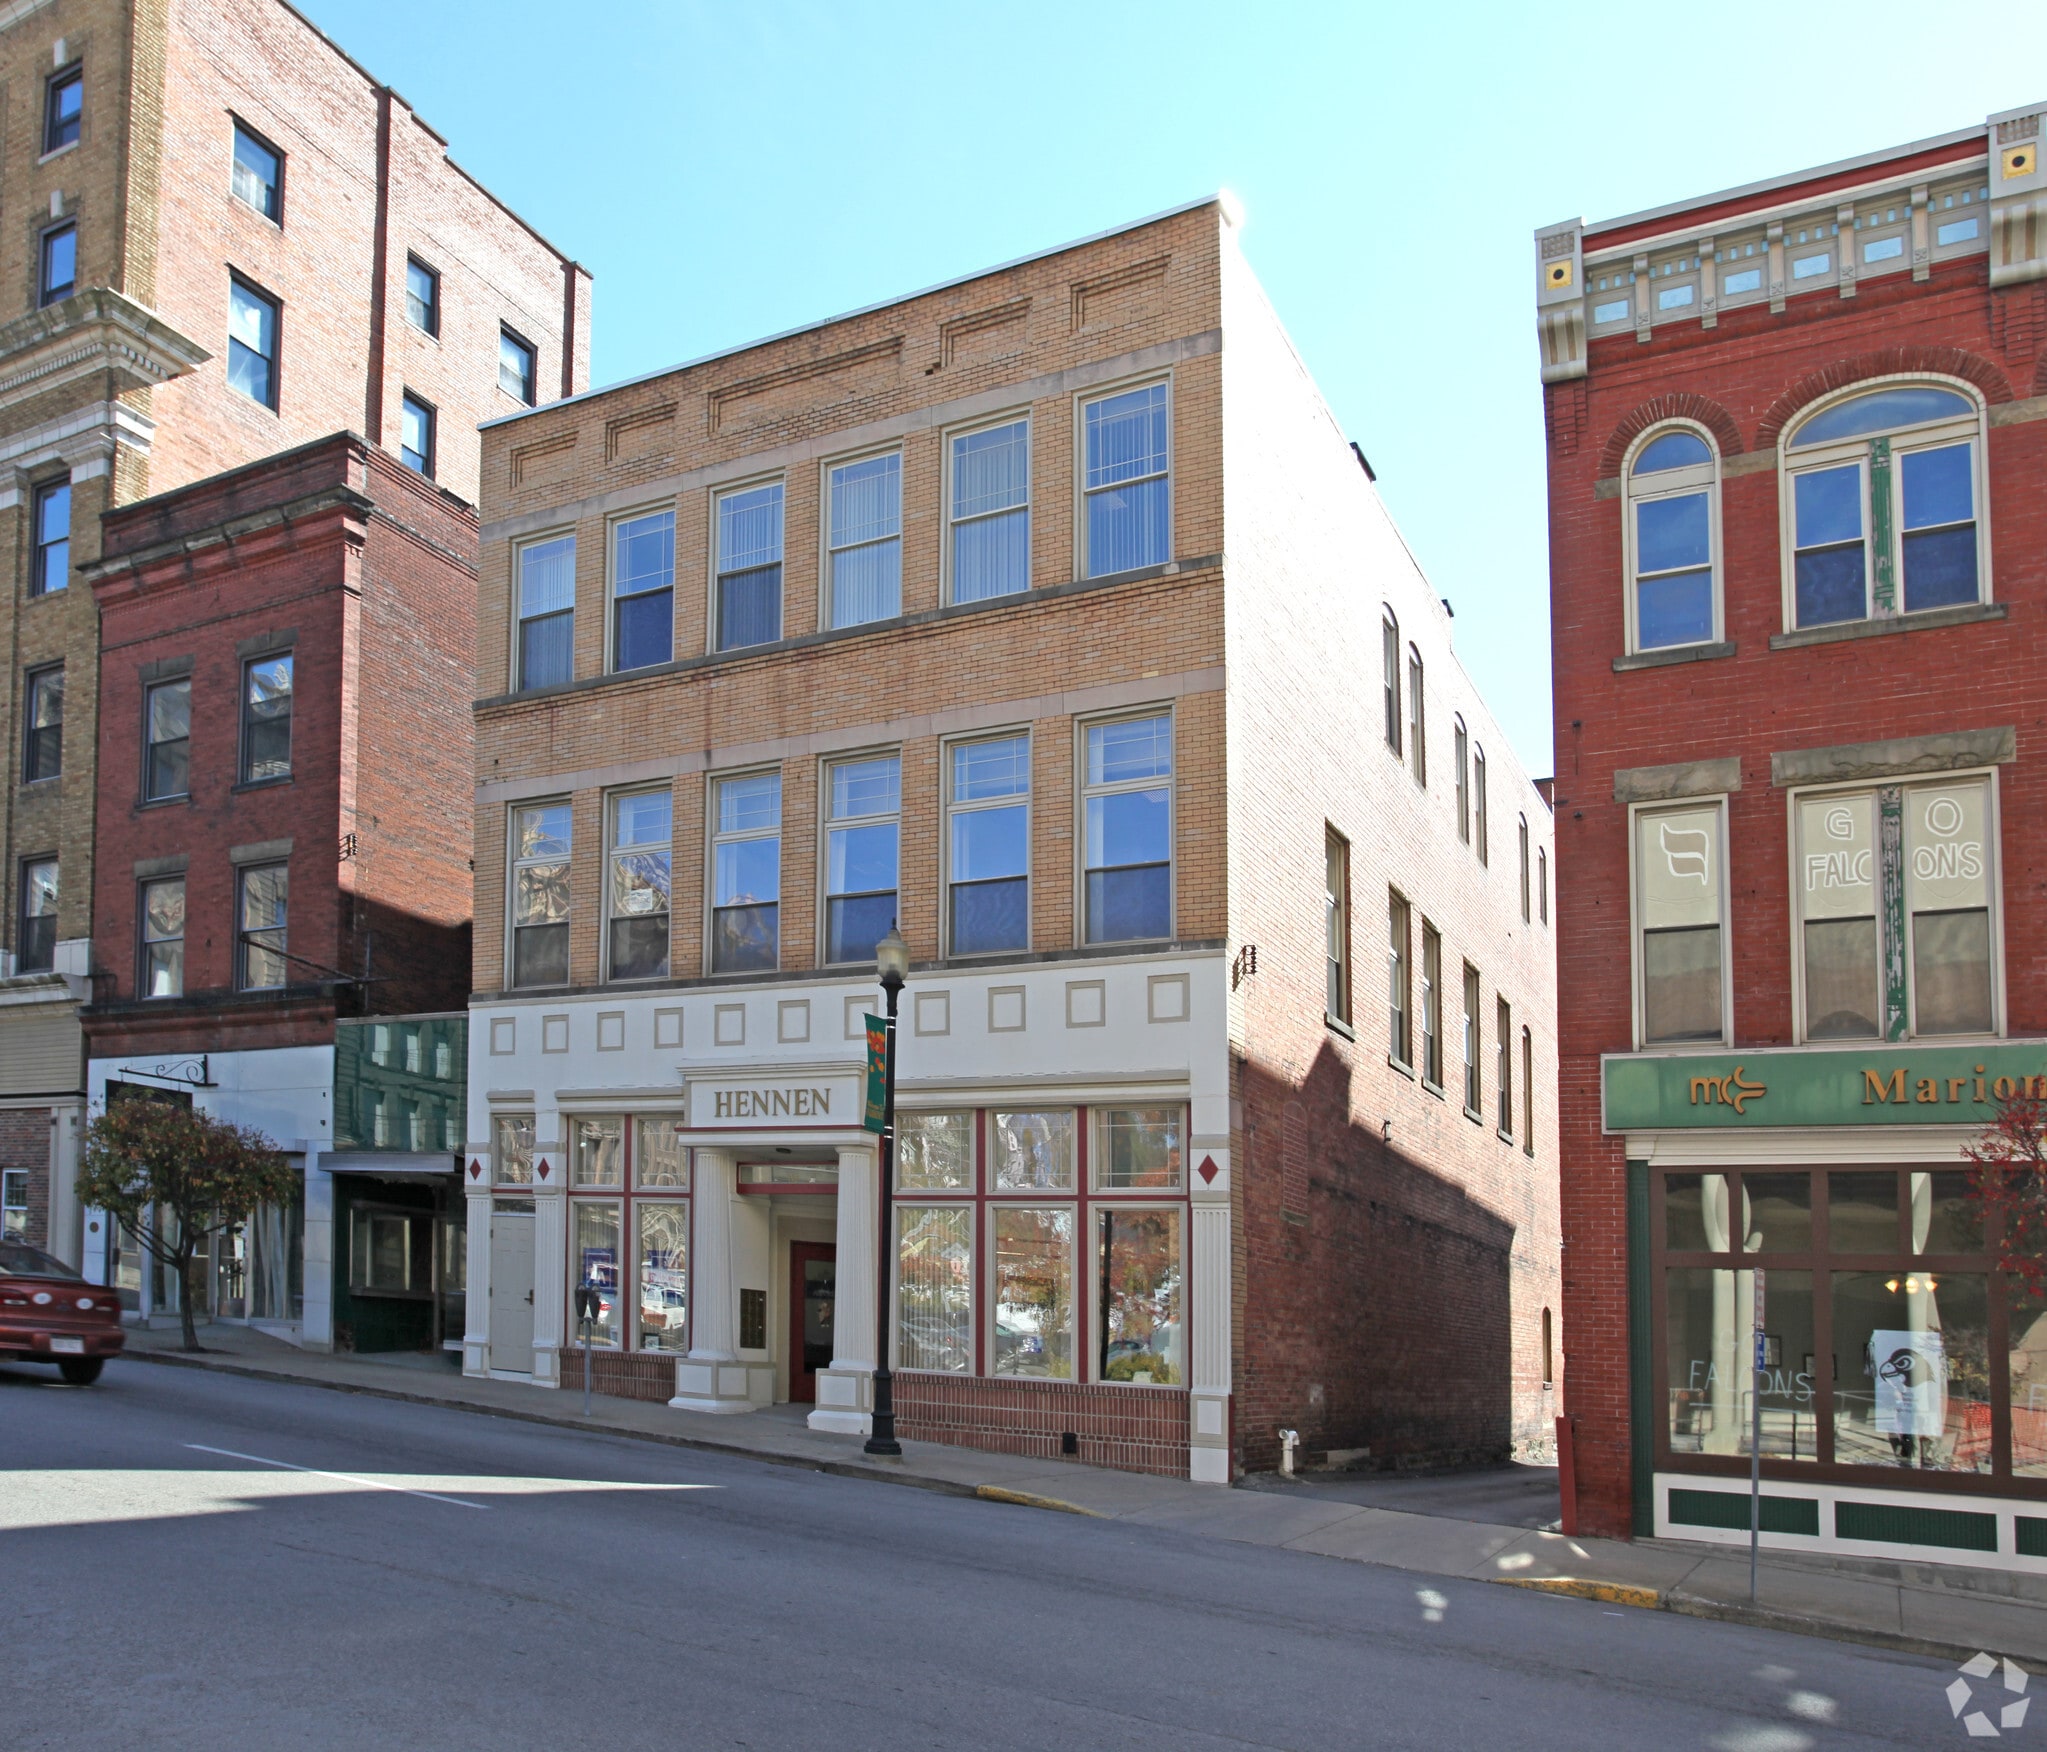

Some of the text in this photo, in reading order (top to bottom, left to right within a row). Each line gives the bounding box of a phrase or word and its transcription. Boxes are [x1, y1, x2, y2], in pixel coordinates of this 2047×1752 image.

[714, 1088, 831, 1118] HENNEN
[1861, 1064, 2047, 1104] Marion
[1689, 1359, 1812, 1402] FALCONS
